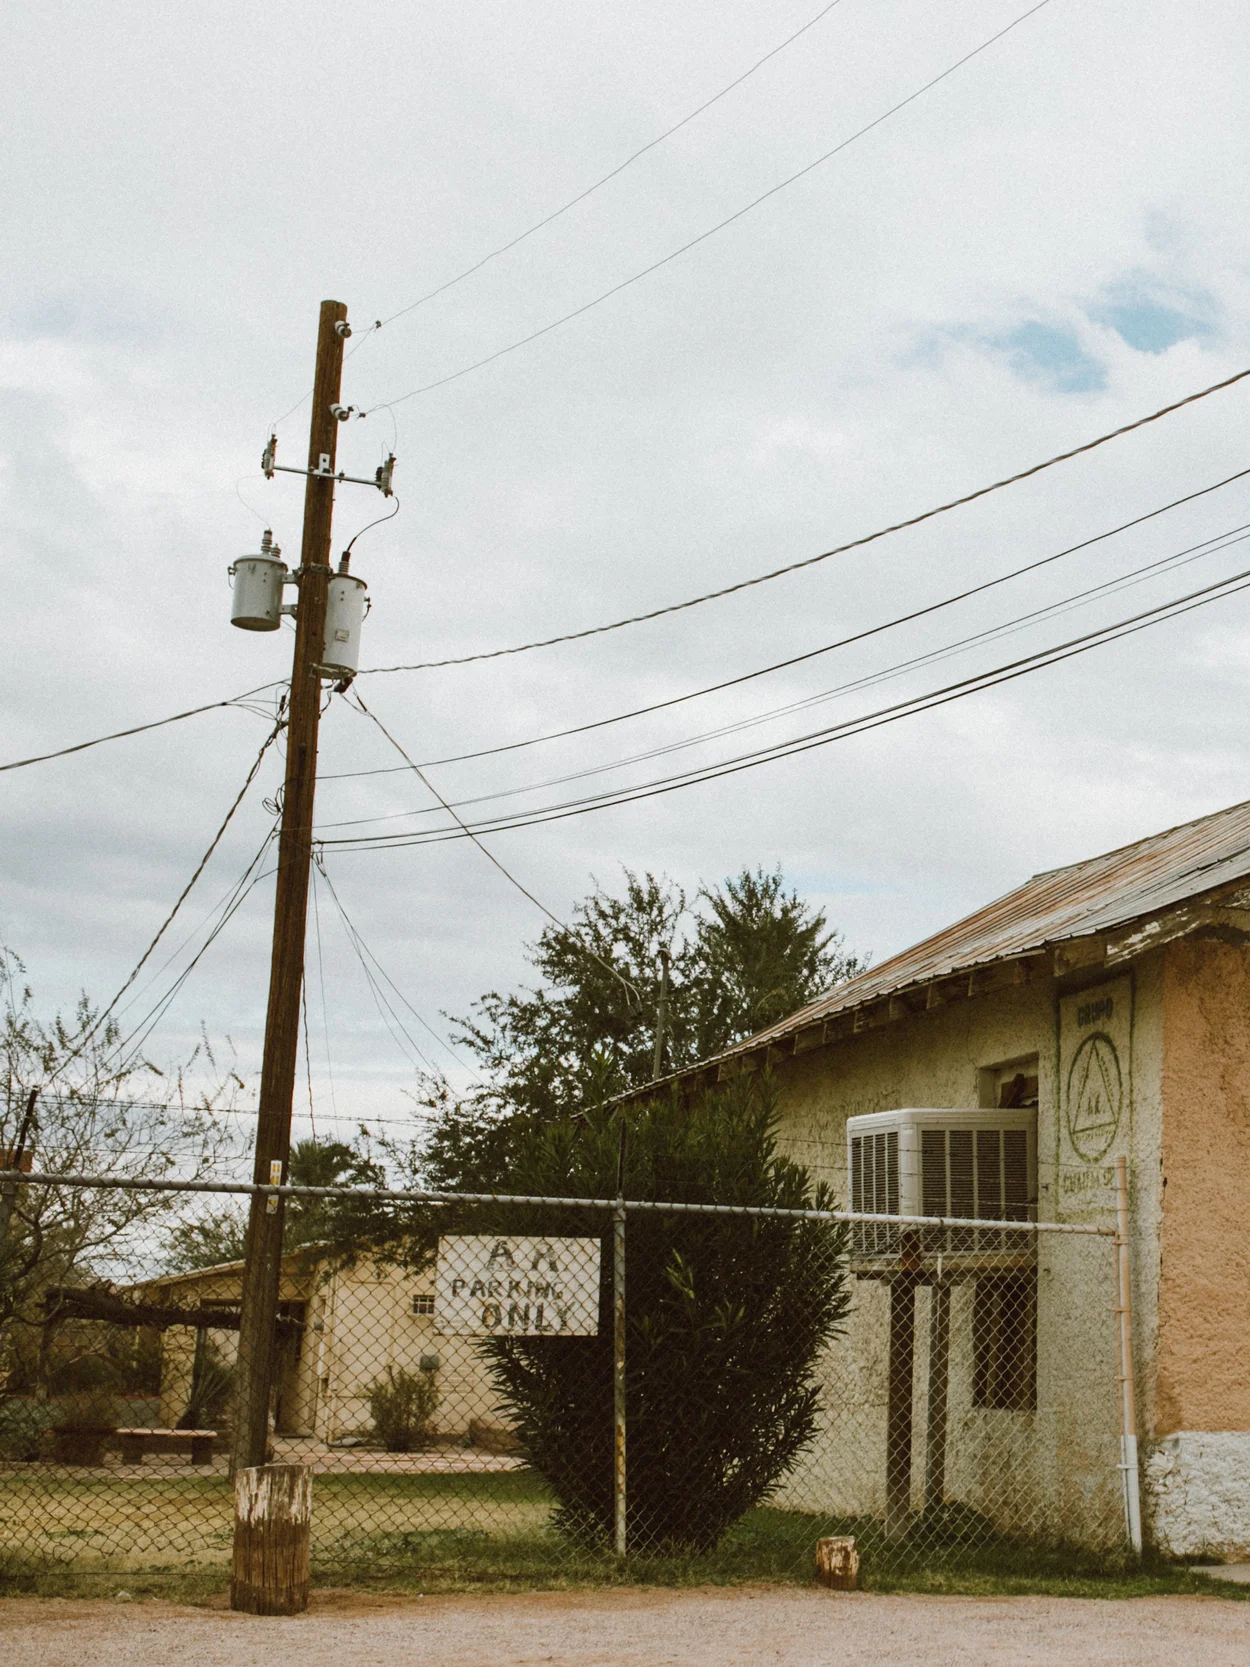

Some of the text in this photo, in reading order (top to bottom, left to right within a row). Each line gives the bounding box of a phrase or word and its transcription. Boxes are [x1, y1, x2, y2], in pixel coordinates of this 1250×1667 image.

[1078, 997, 1113, 1027] GRUPO
[451, 1279, 564, 1299] PARKING
[482, 1301, 576, 1332] ONLY
